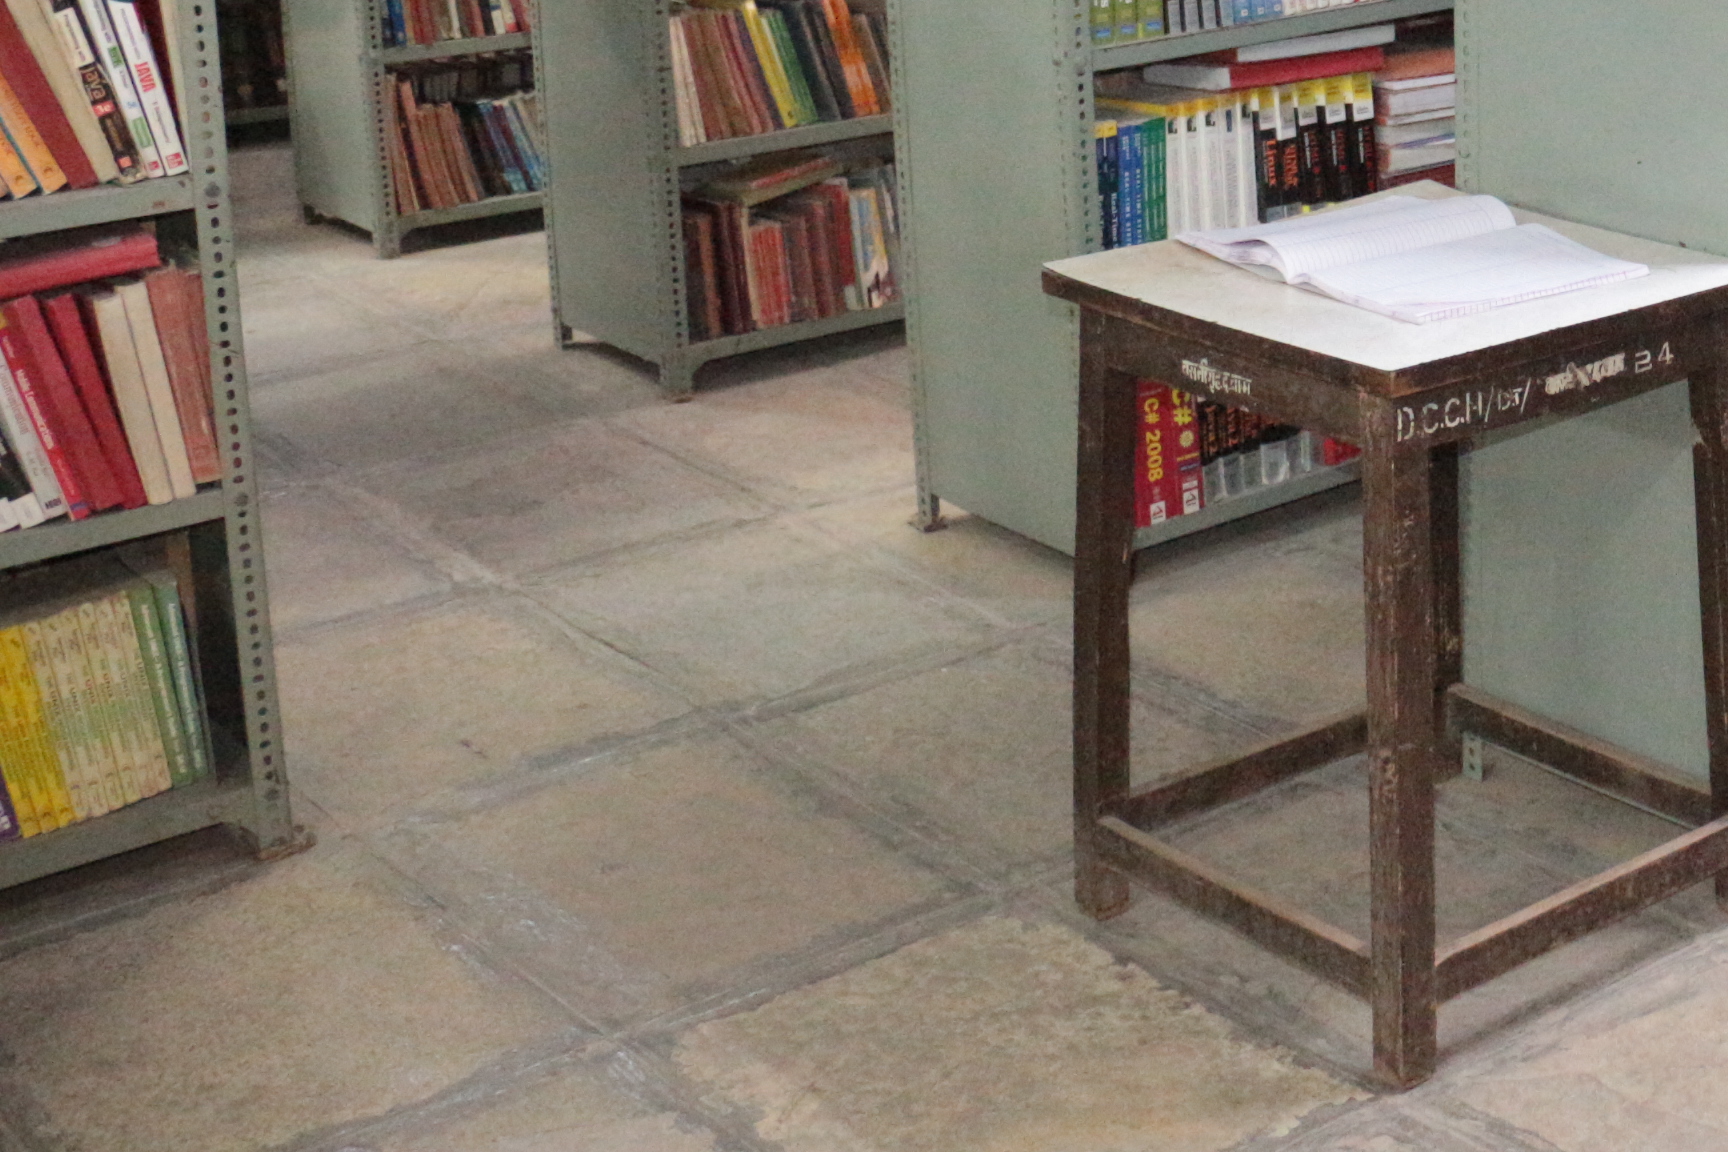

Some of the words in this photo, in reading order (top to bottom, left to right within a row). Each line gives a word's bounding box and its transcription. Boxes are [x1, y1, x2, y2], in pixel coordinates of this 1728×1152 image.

[81, 66, 106, 100] Java
[134, 61, 157, 93] JAVA
[1143, 397, 1161, 425] C#
[1145, 429, 1164, 483] 2008
